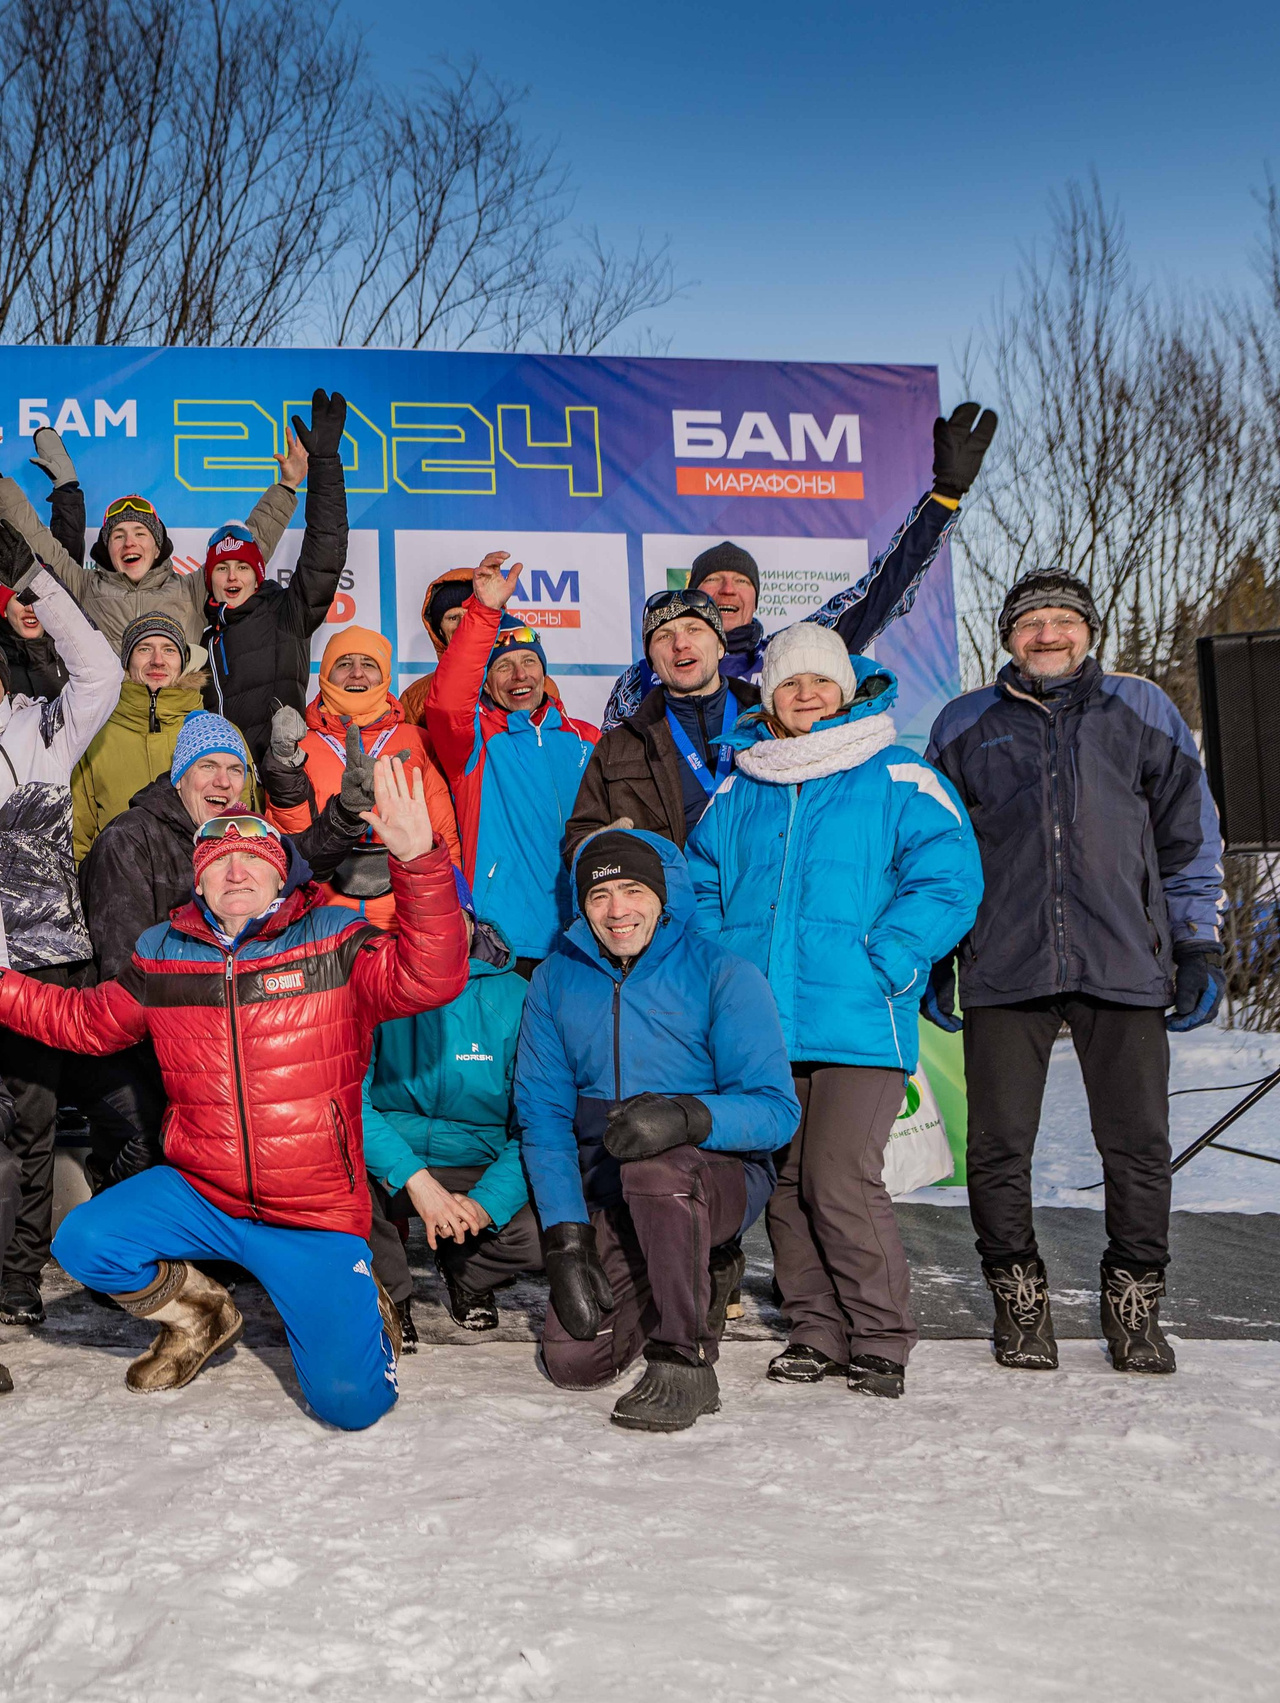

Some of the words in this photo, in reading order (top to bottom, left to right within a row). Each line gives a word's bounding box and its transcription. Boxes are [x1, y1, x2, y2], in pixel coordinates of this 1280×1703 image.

[19, 398, 137, 437] БАМ
[672, 409, 862, 463] БАМ
[174, 399, 603, 497] 2024
[705, 472, 836, 494] МАРАФОНЫ
[759, 570, 850, 583] МИНИСТРАЦИЯ
[760, 582, 819, 592] АРСКОГО
[758, 594, 822, 605] РОДСКОГО
[757, 606, 787, 616] РУГА
[925, 1119, 941, 1129] ВАМ
